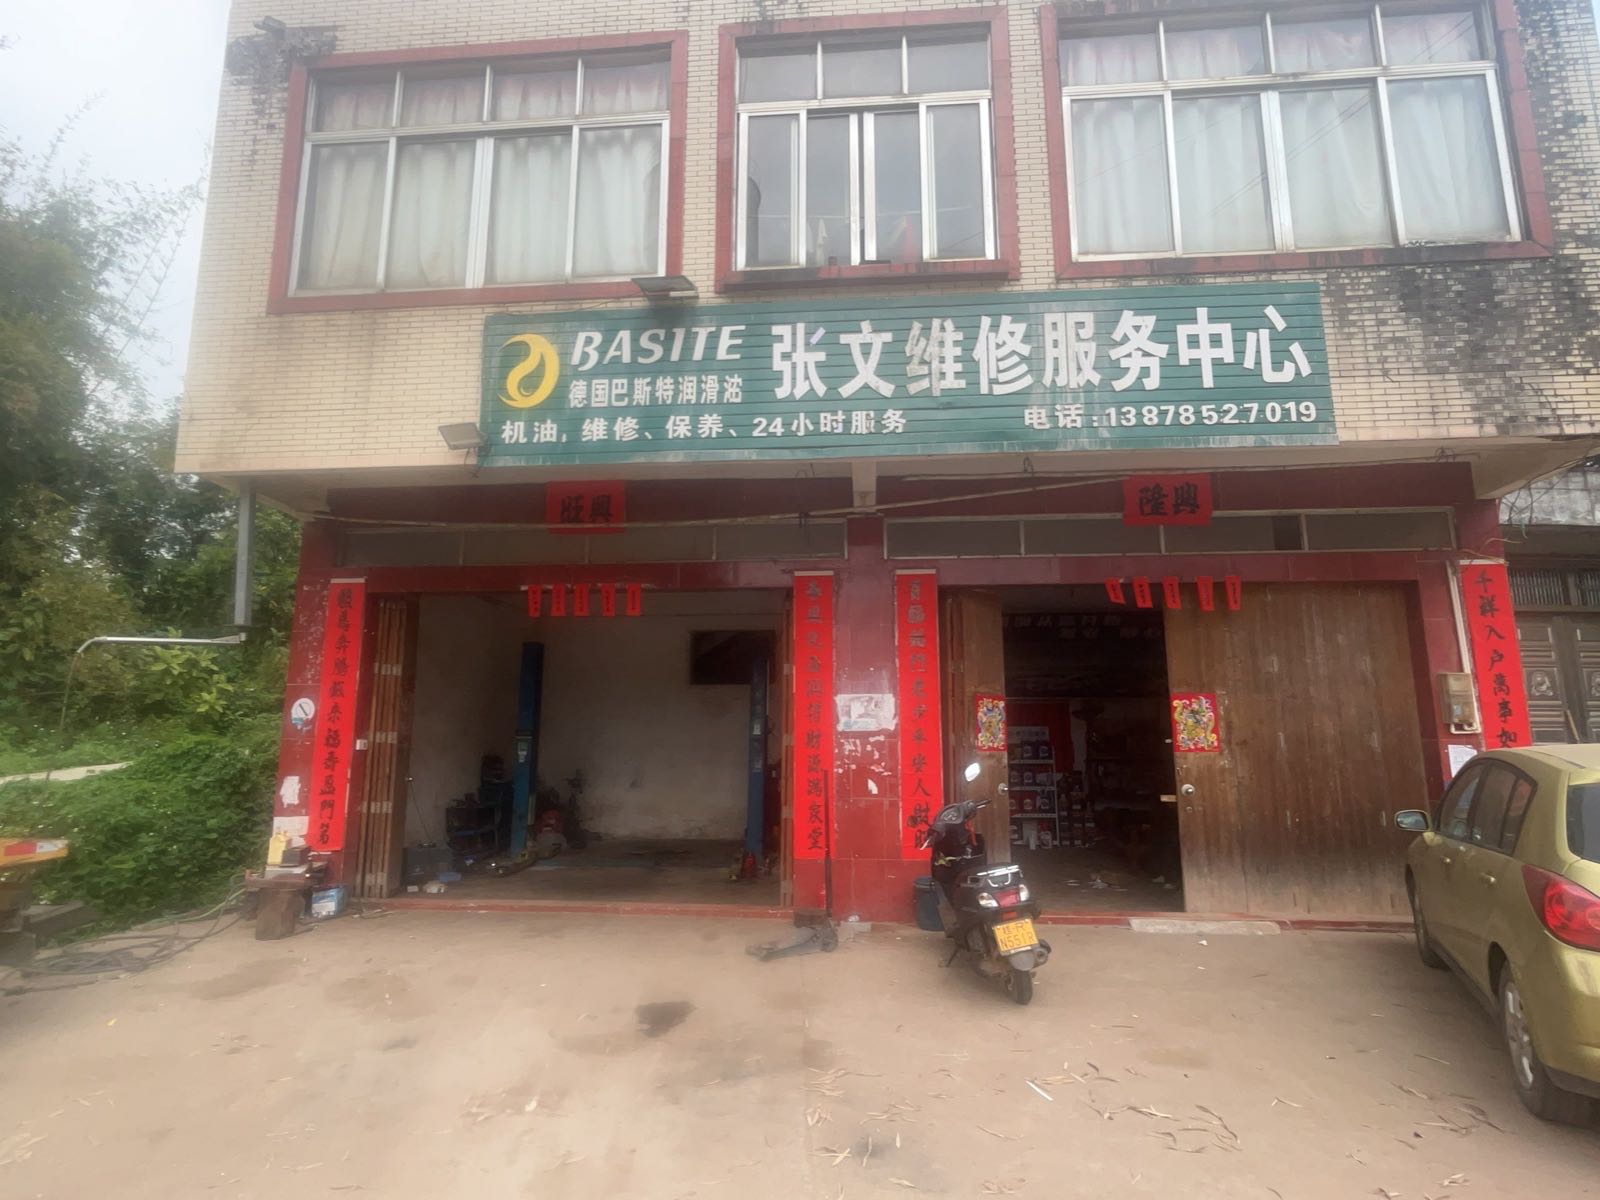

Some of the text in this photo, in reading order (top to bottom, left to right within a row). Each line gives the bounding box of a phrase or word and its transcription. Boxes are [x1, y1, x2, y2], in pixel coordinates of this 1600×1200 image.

[569, 324, 746, 372] BASITE
[770, 305, 1313, 399] 张文维修服务中心
